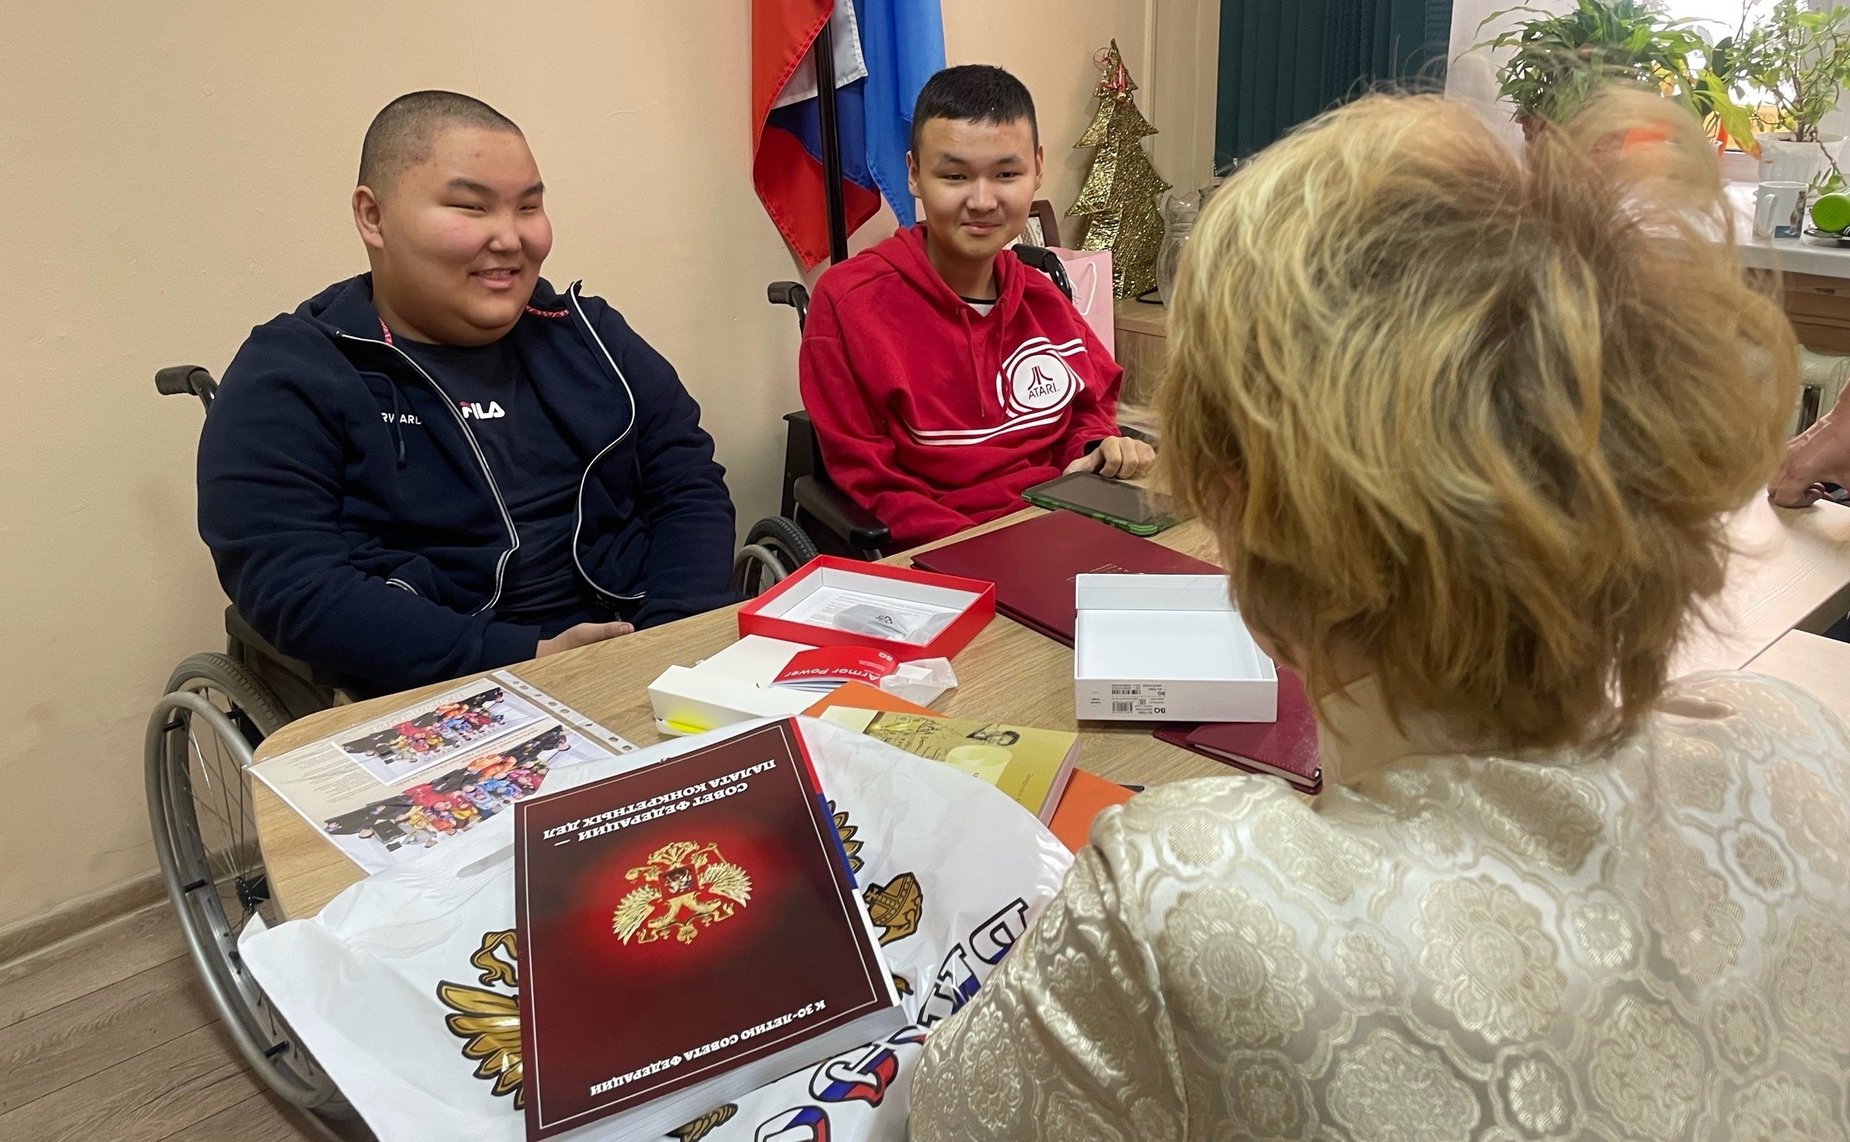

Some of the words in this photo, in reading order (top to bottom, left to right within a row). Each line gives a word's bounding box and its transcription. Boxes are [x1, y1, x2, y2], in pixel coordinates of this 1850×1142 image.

[1028, 382, 1058, 400] ATARI
[459, 400, 506, 420] FILA
[784, 667, 830, 678] Power
[831, 668, 880, 681] Armor
[708, 759, 777, 789] ПАЛАТА
[582, 784, 707, 828] КОНКРЕТНЫХ
[692, 782, 749, 807] СОВЕТ
[543, 818, 581, 840] ДЕЛ
[578, 799, 691, 842] ФЕДЕРАЦИИ
[815, 999, 827, 1012] К
[741, 1005, 815, 1040] 30-ЛЕТИЮ
[683, 1034, 739, 1061] СОВЕТА
[590, 1055, 683, 1097] ФЕДЕРАЦИИ
